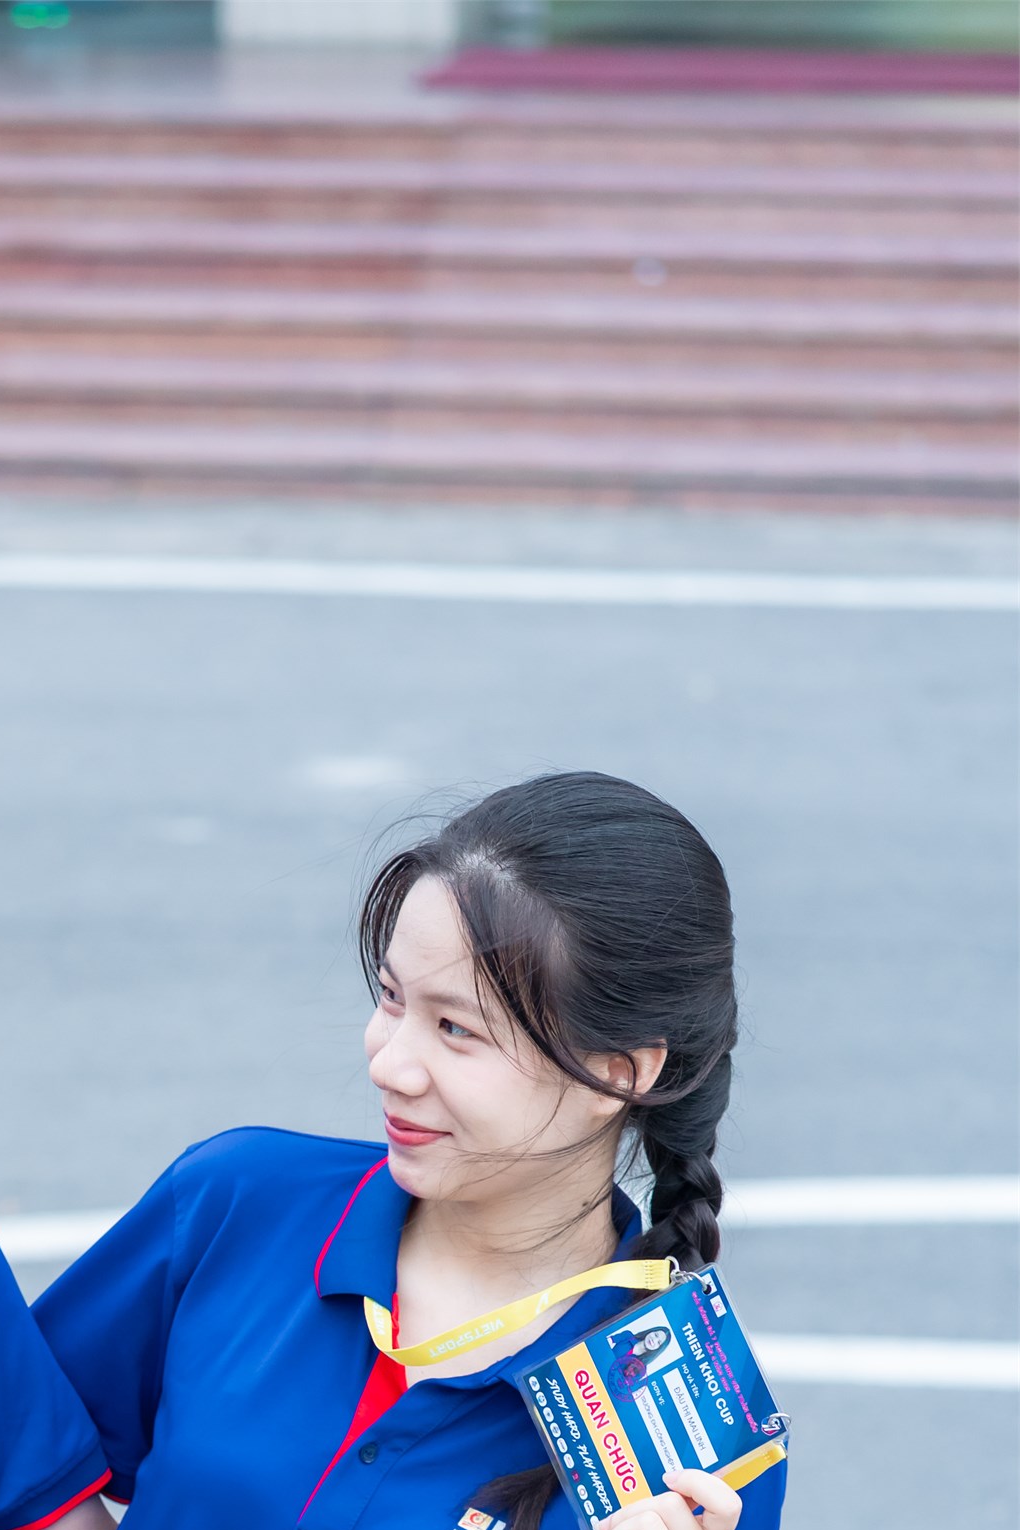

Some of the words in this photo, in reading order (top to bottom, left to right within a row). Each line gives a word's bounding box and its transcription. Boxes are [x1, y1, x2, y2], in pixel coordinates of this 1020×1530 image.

[650, 1379, 662, 1397] ĐƠN
[680, 1362, 689, 1375] HỌ
[685, 1373, 694, 1384] VÀ
[697, 1360, 721, 1397] KHOI
[713, 1395, 735, 1428] CUP
[545, 1373, 569, 1412] STUDY
[559, 1408, 583, 1443] HARD,
[574, 1442, 596, 1474] PLAY
[586, 1468, 614, 1515] HARDER
[574, 1369, 610, 1430] QUAN
[601, 1431, 639, 1494] CHỨC
[686, 1416, 698, 1433] MAI
[693, 1432, 706, 1451] LINH
